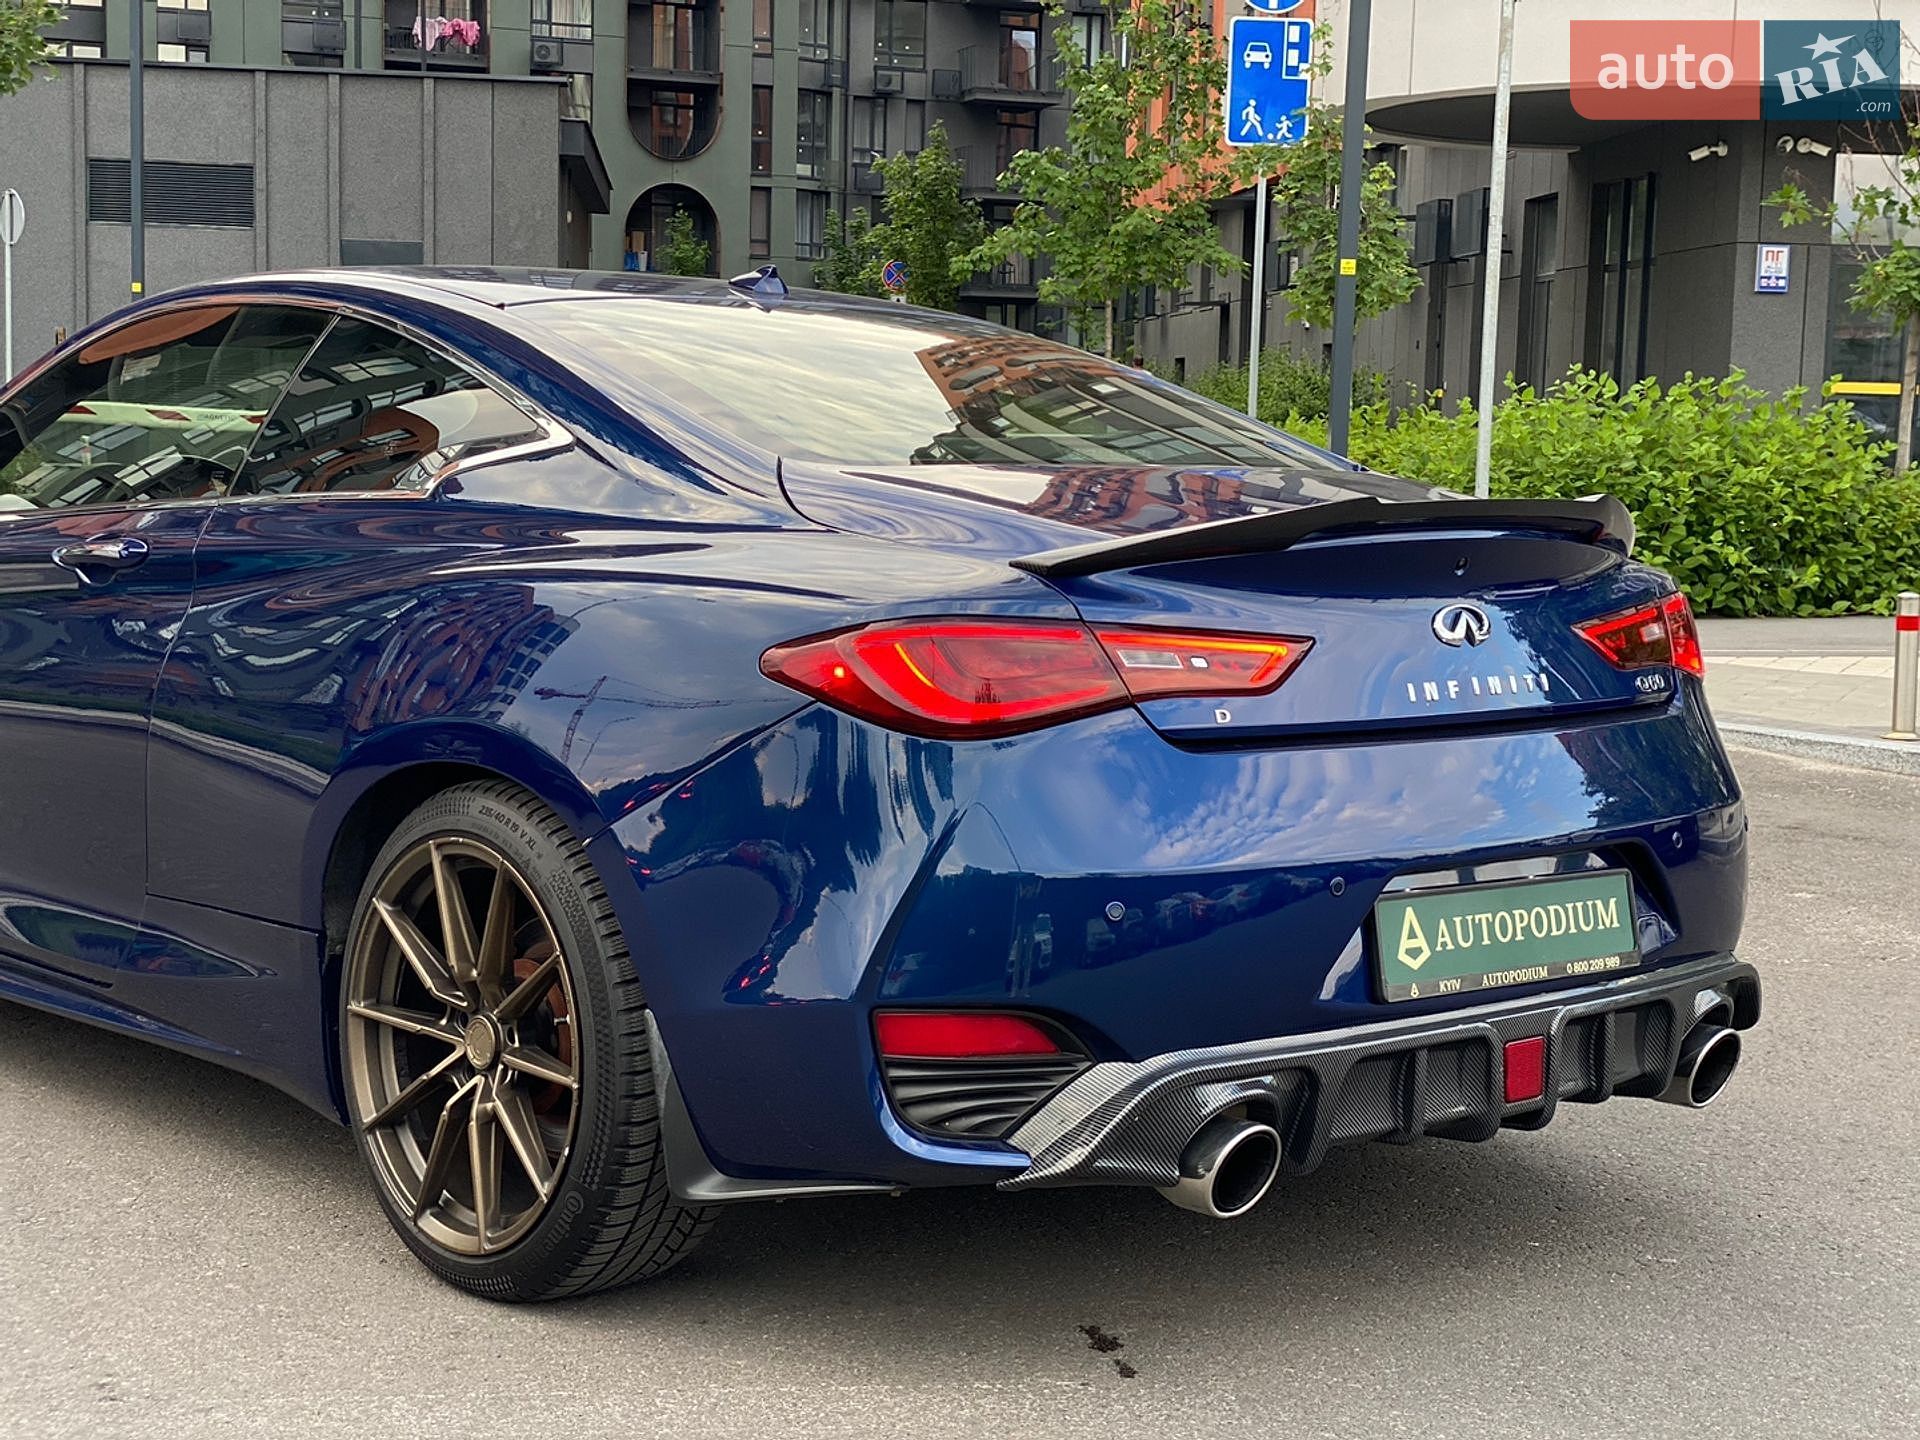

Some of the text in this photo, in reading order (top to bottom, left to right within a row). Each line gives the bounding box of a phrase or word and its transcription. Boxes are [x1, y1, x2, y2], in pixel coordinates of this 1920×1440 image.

[1406, 673, 1550, 703] INFINITI
[1635, 673, 1665, 692] Q60
[1215, 709, 1231, 724] D
[1435, 897, 1621, 952] AUTOPODIUM
[1439, 978, 1461, 993] KYIV
[1481, 966, 1548, 988] AUTOPODIUM
[1566, 962, 1573, 974] 0
